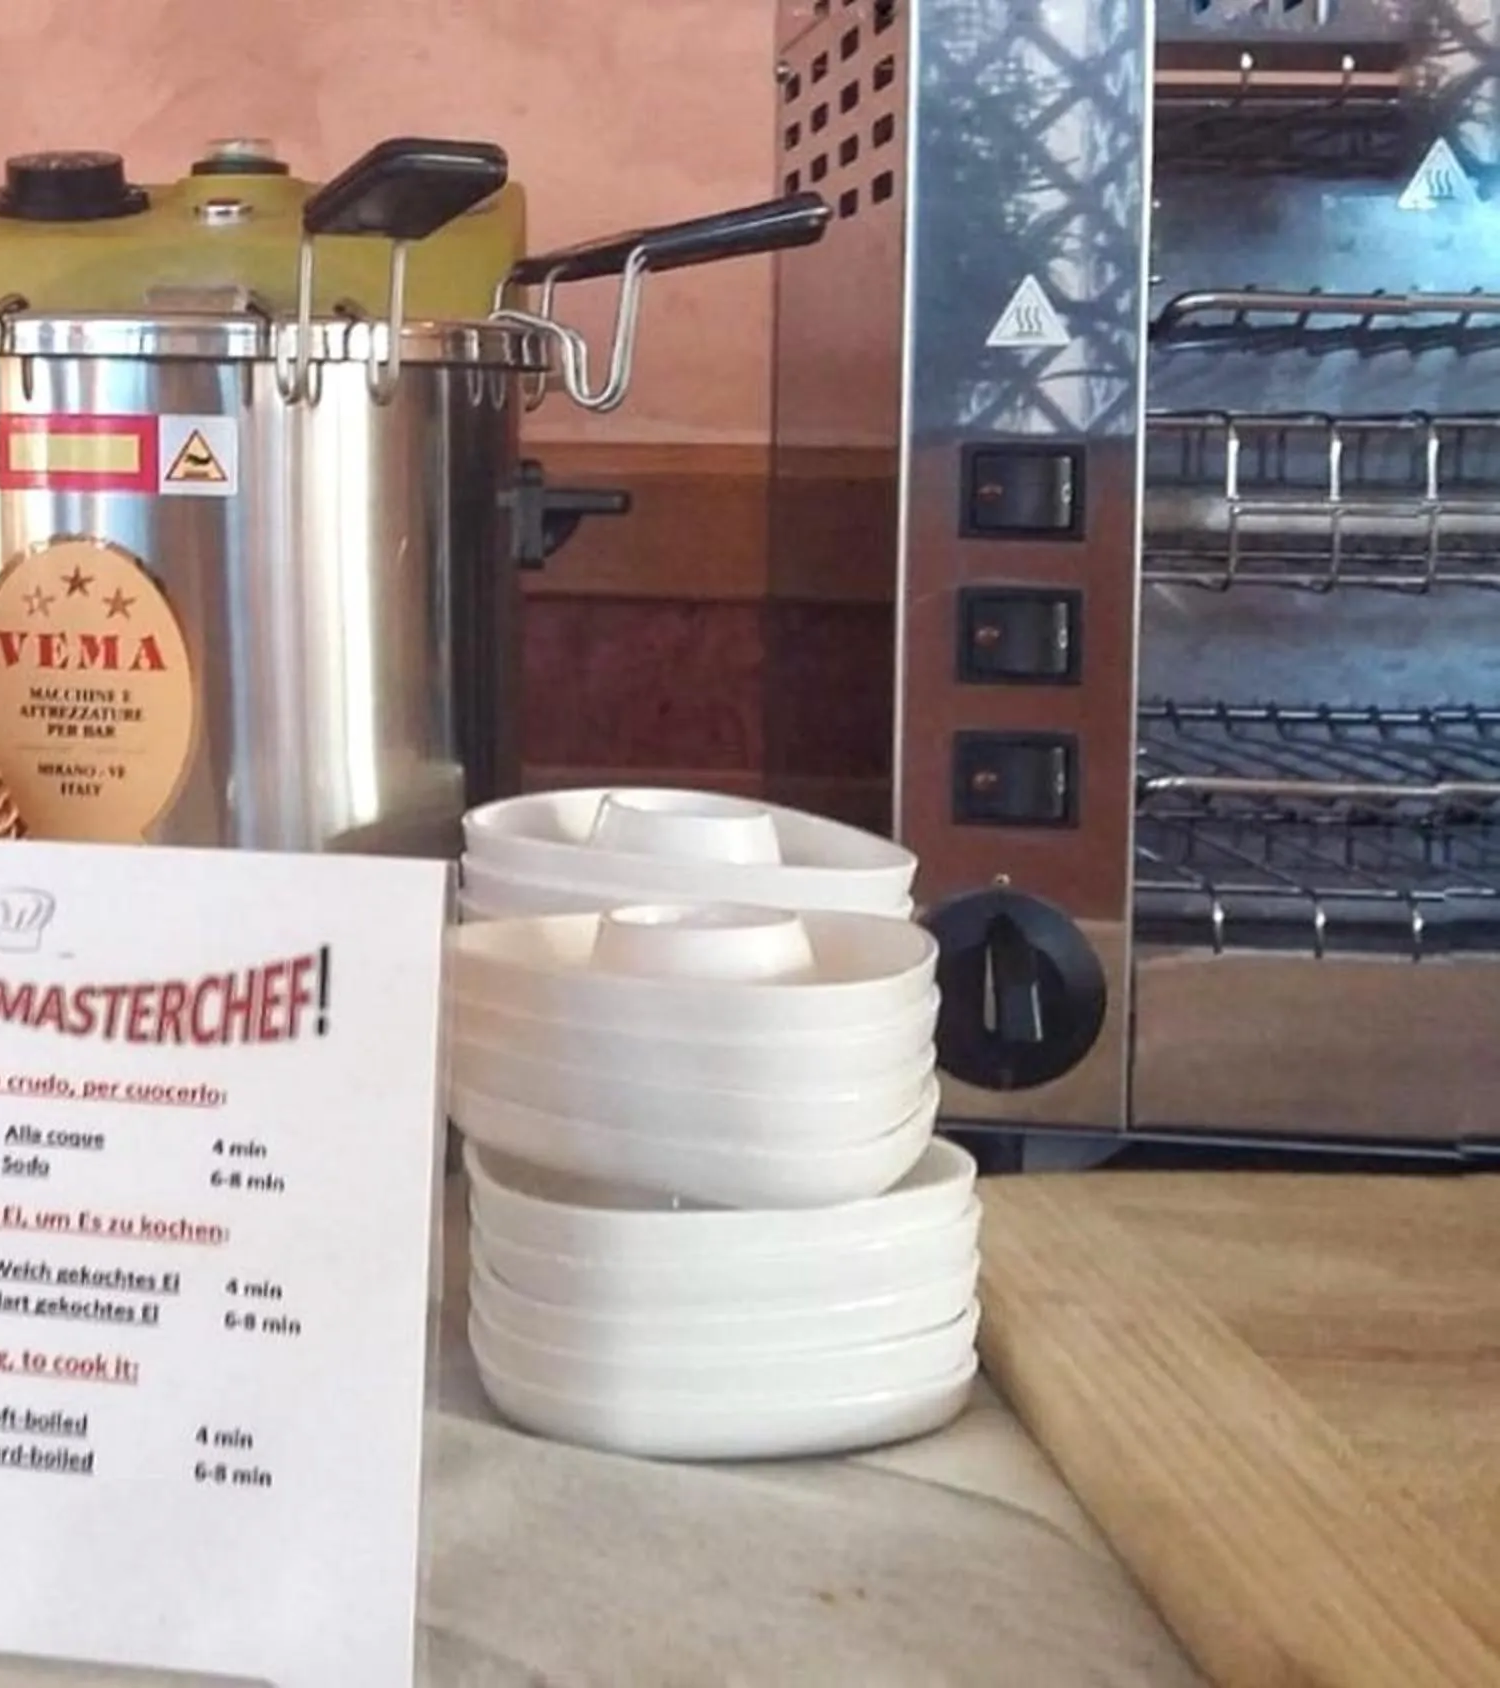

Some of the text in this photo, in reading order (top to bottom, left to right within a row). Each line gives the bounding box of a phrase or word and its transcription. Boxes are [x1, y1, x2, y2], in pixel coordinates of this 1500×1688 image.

[29, 686, 132, 704] MACCHINE E
[19, 704, 143, 722] ATTREZZATURE
[47, 723, 116, 739] PER BAR
[60, 782, 102, 797] ITALY
[7, 1073, 76, 1098] crudo,
[82, 1081, 119, 1101] per
[125, 1083, 227, 1107] cuocerlo:
[4, 1123, 267, 1159] Alla coque 4 min
[210, 1170, 241, 1189] 6-8
[247, 1172, 285, 1193] min
[2, 1206, 28, 1229] Ei,
[35, 1212, 70, 1231] um
[78, 1212, 101, 1231] Es
[109, 1217, 133, 1234] zu
[140, 1215, 229, 1243] kochen:
[56, 1265, 156, 1292] gekochtes
[161, 1271, 181, 1294] Ei
[225, 1277, 238, 1296] 4
[244, 1279, 283, 1301] min
[34, 1296, 135, 1323] gekochtes
[140, 1303, 160, 1325] Ei
[224, 1309, 256, 1331] 6-8
[262, 1312, 301, 1335] min
[22, 1350, 47, 1373] to
[52, 1353, 107, 1379] cook
[113, 1357, 140, 1385] it:
[195, 1425, 208, 1445] 4
[213, 1427, 253, 1450] min
[194, 1461, 227, 1484] 6-8
[232, 1463, 272, 1488] min
